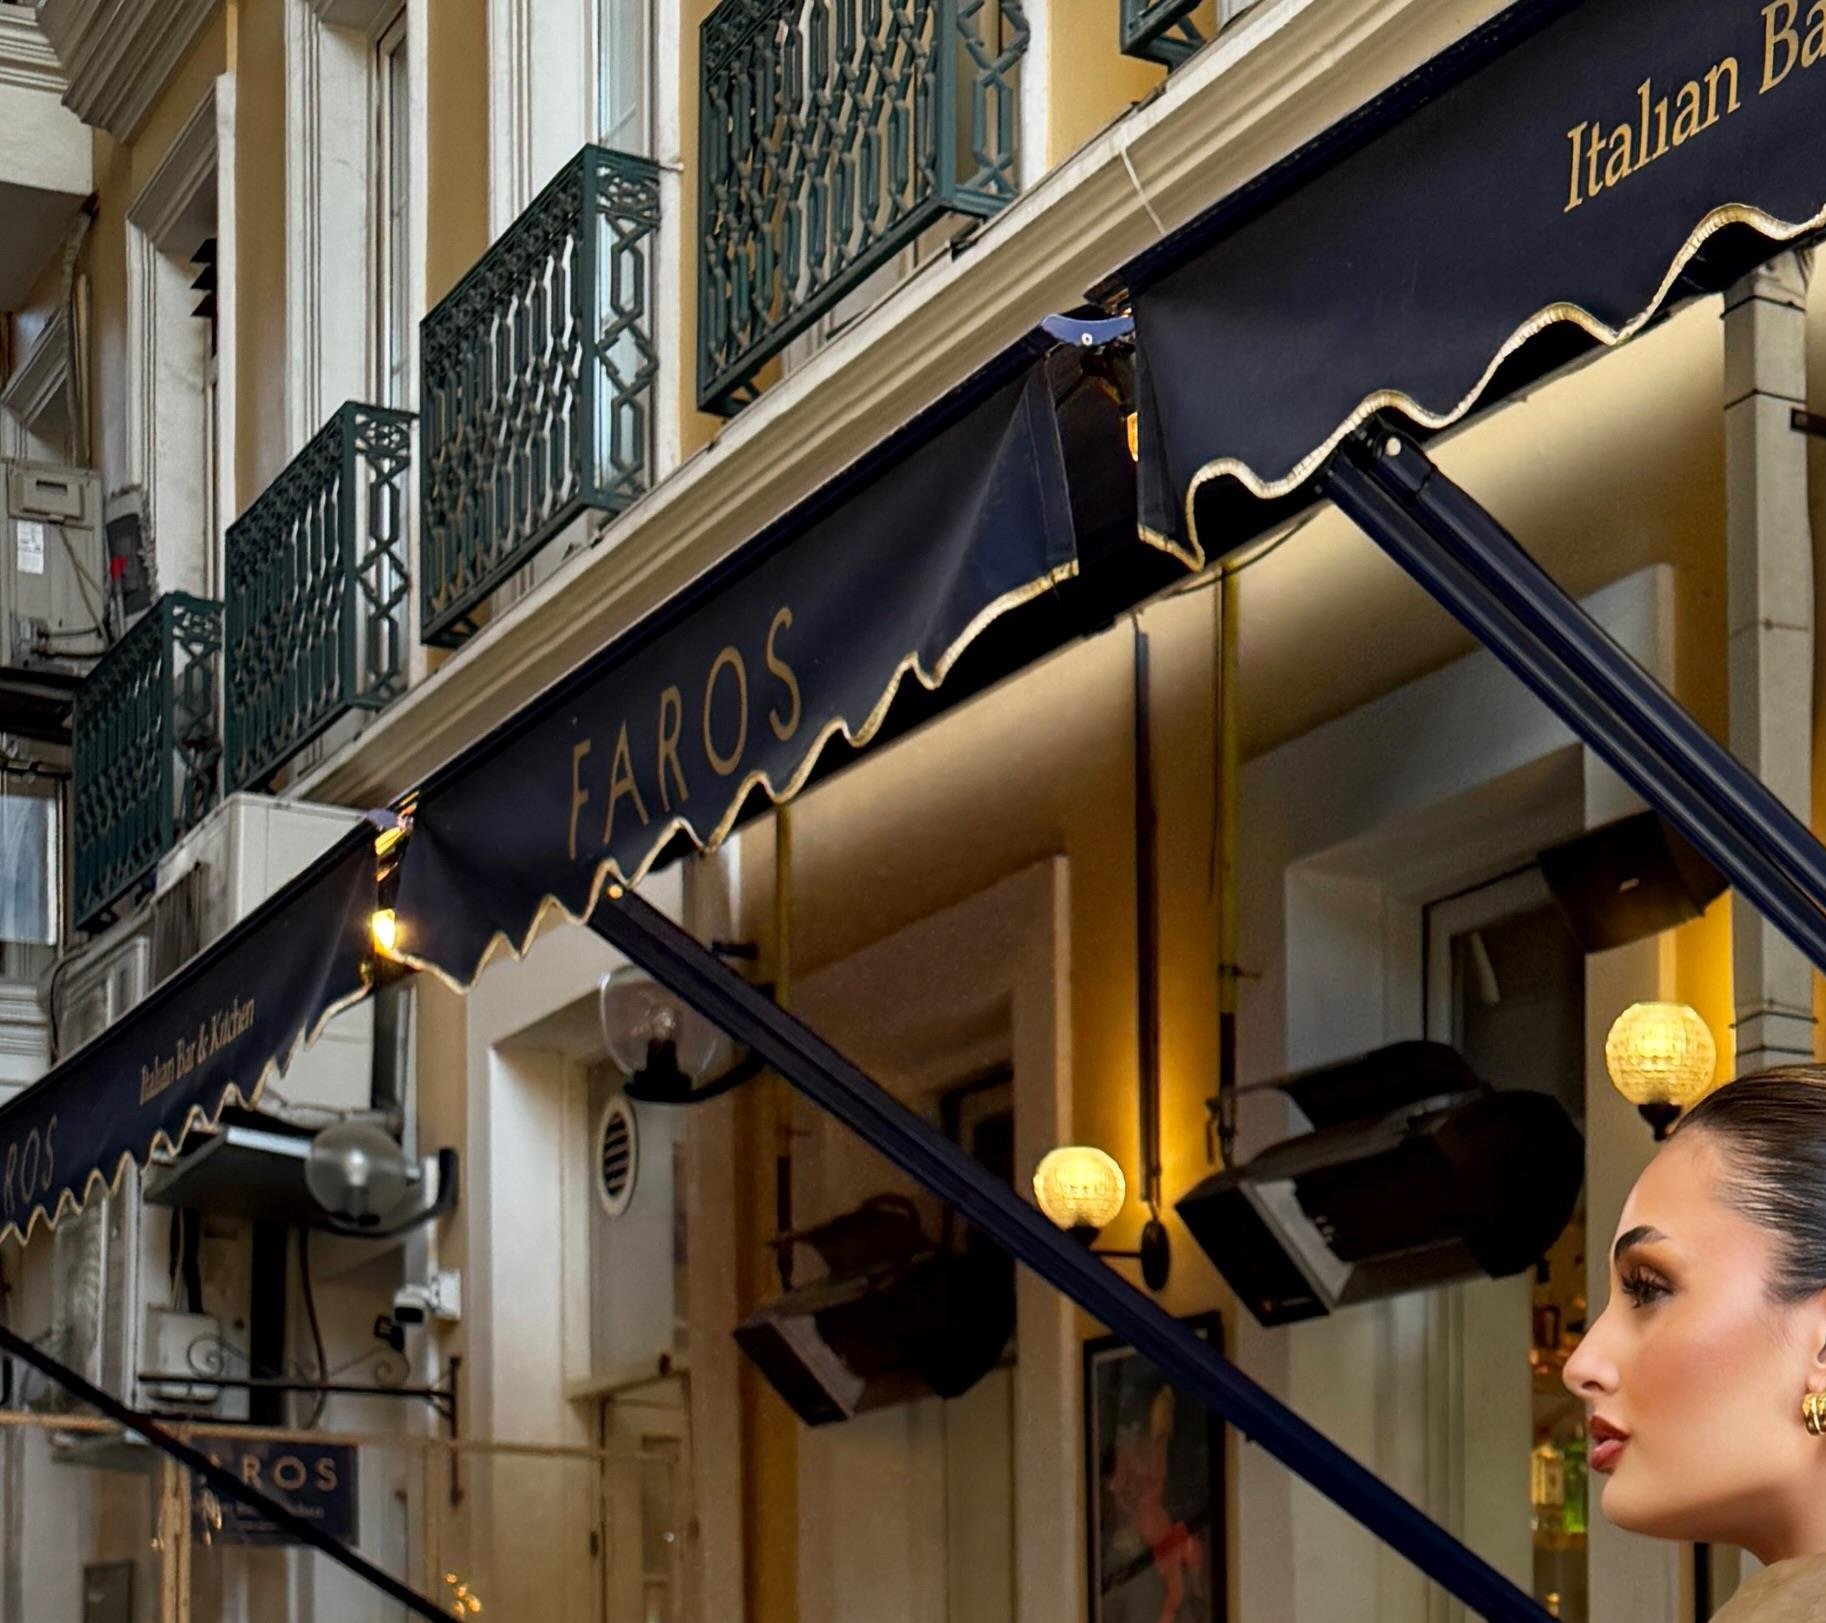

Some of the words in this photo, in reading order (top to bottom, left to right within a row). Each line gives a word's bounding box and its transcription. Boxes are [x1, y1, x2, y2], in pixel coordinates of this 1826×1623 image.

[1562, 55, 1742, 214] Italian
[567, 605, 802, 861] FAROS
[3, 1112, 58, 1216] ROS
[208, 1453, 338, 1492] ROS
